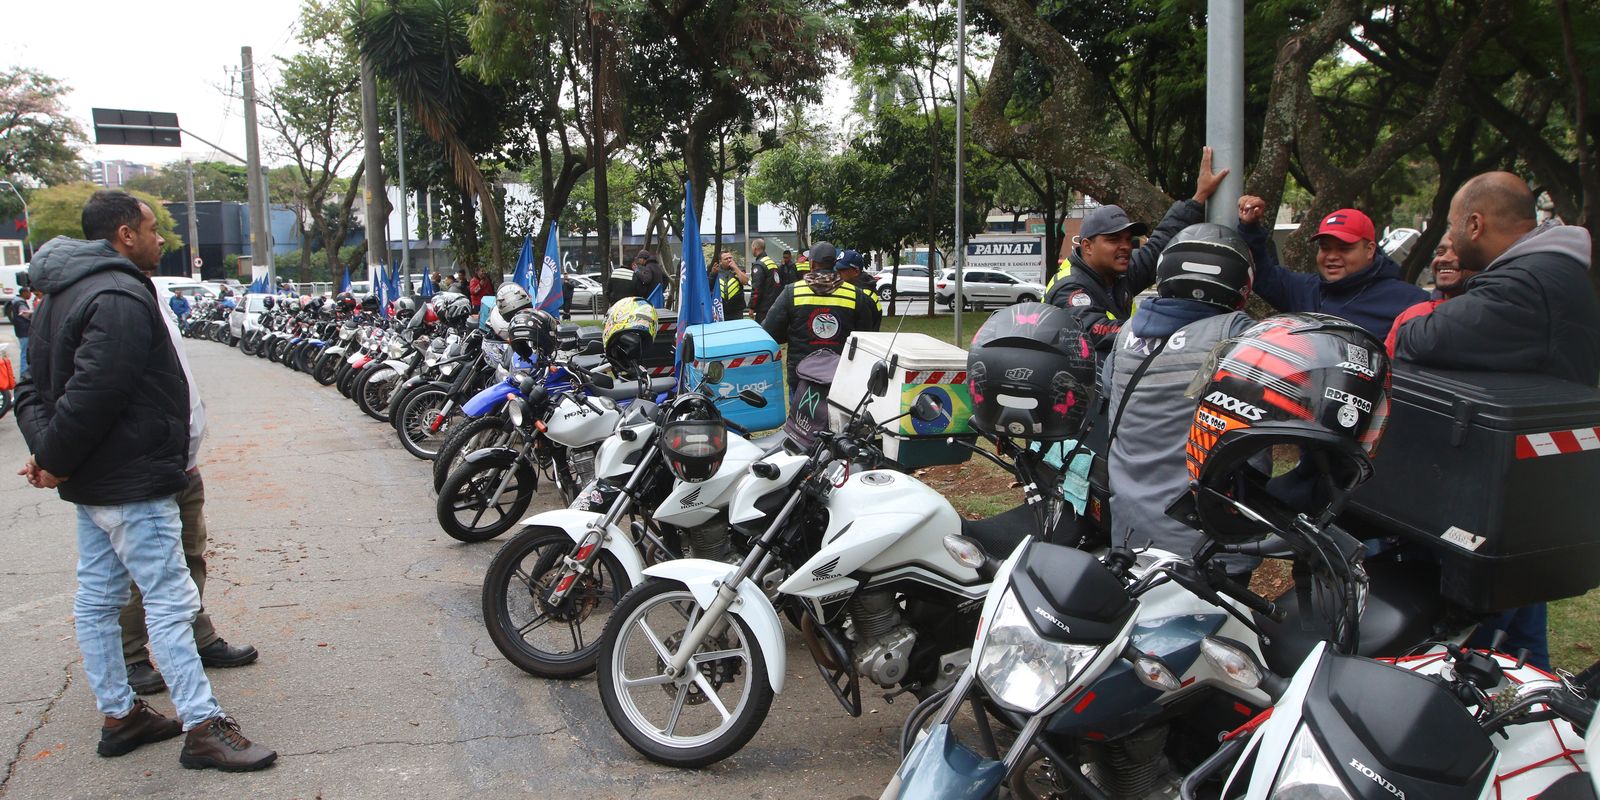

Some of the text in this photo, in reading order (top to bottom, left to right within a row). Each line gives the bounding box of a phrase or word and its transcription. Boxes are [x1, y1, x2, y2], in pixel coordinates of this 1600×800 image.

[974, 243, 1034, 255] PANNAN
[1204, 390, 1268, 421] AXXIS
[1326, 388, 1371, 412] RDG 9060
[564, 408, 592, 420] HOND
[1198, 411, 1226, 430] RDG 9060
[680, 501, 704, 509] HONDA
[812, 573, 843, 582] HONDA
[1034, 606, 1071, 634] HONDA
[1348, 757, 1406, 800] HONDA
